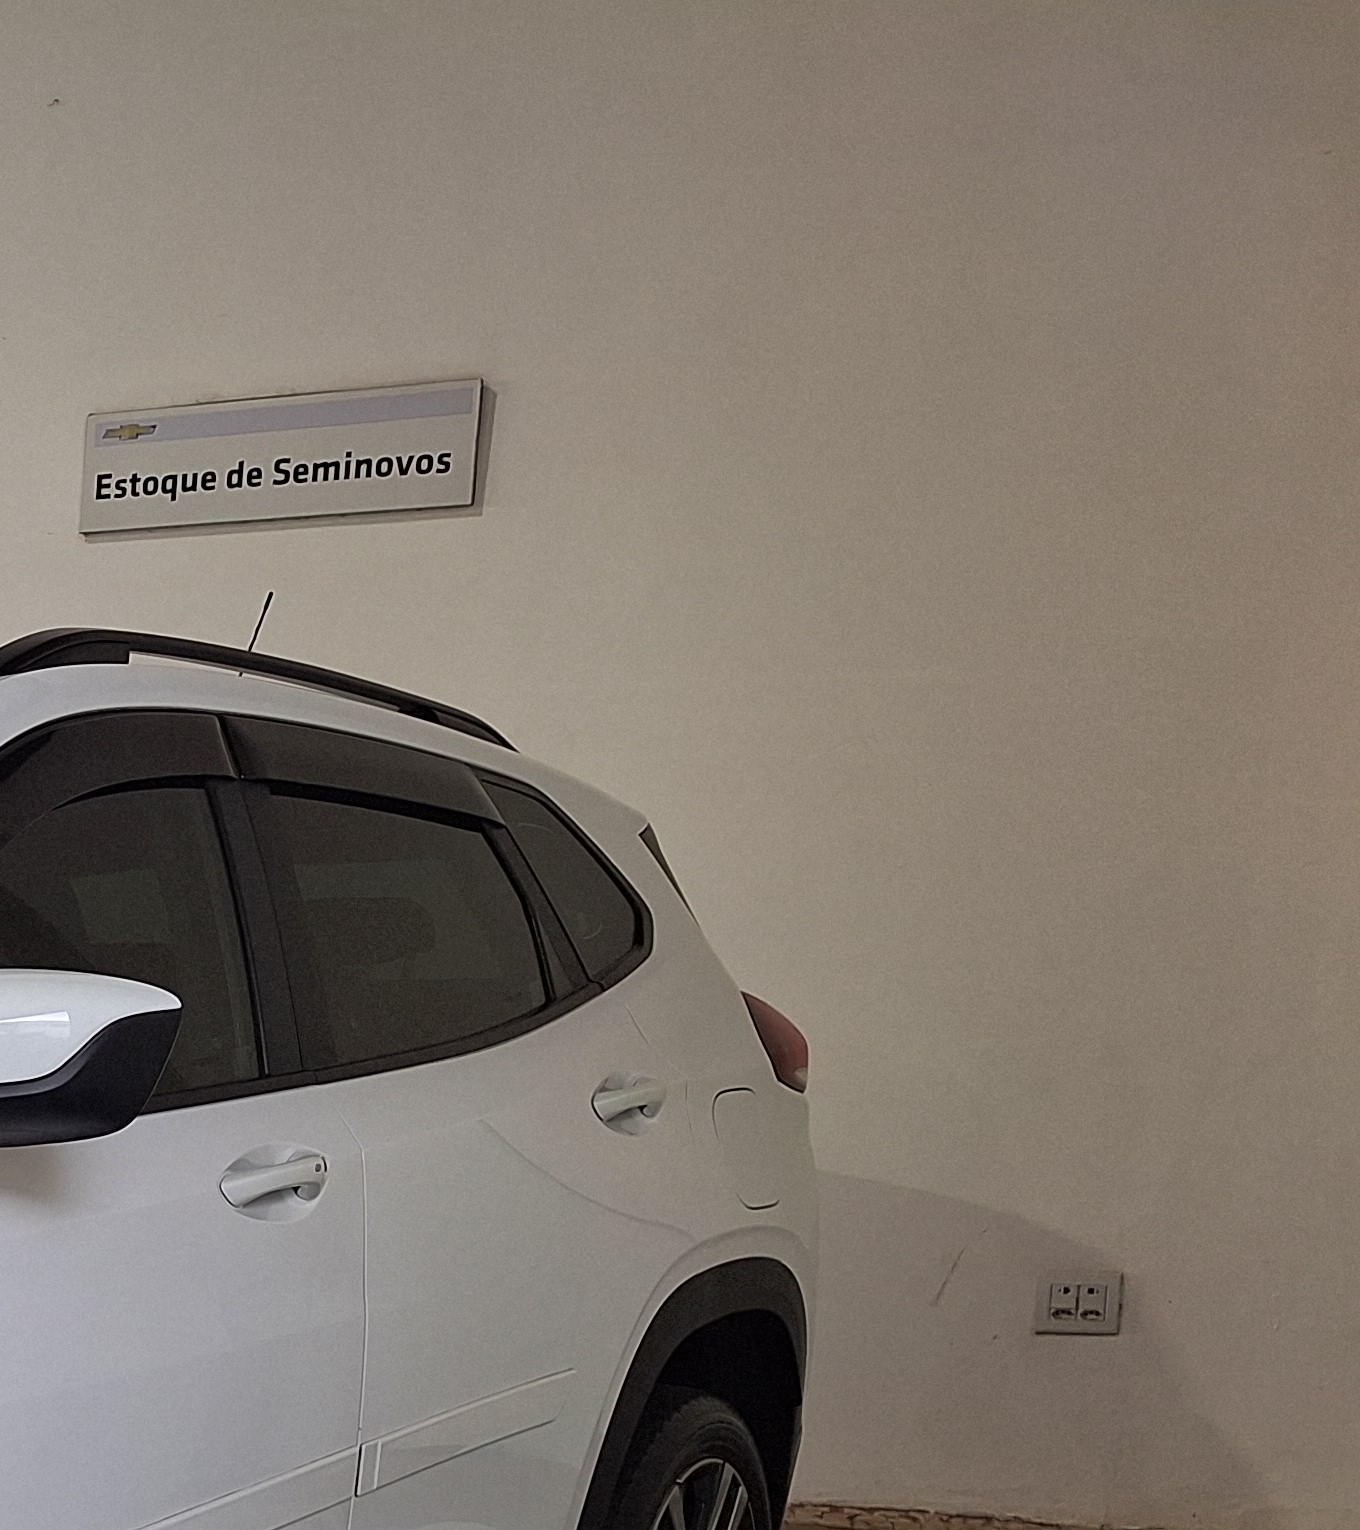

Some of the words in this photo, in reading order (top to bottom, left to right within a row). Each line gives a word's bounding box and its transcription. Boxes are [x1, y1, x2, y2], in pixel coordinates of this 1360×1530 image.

[95, 469, 217, 501] Estoque
[226, 460, 263, 489] de
[272, 451, 452, 486] Seminovos
